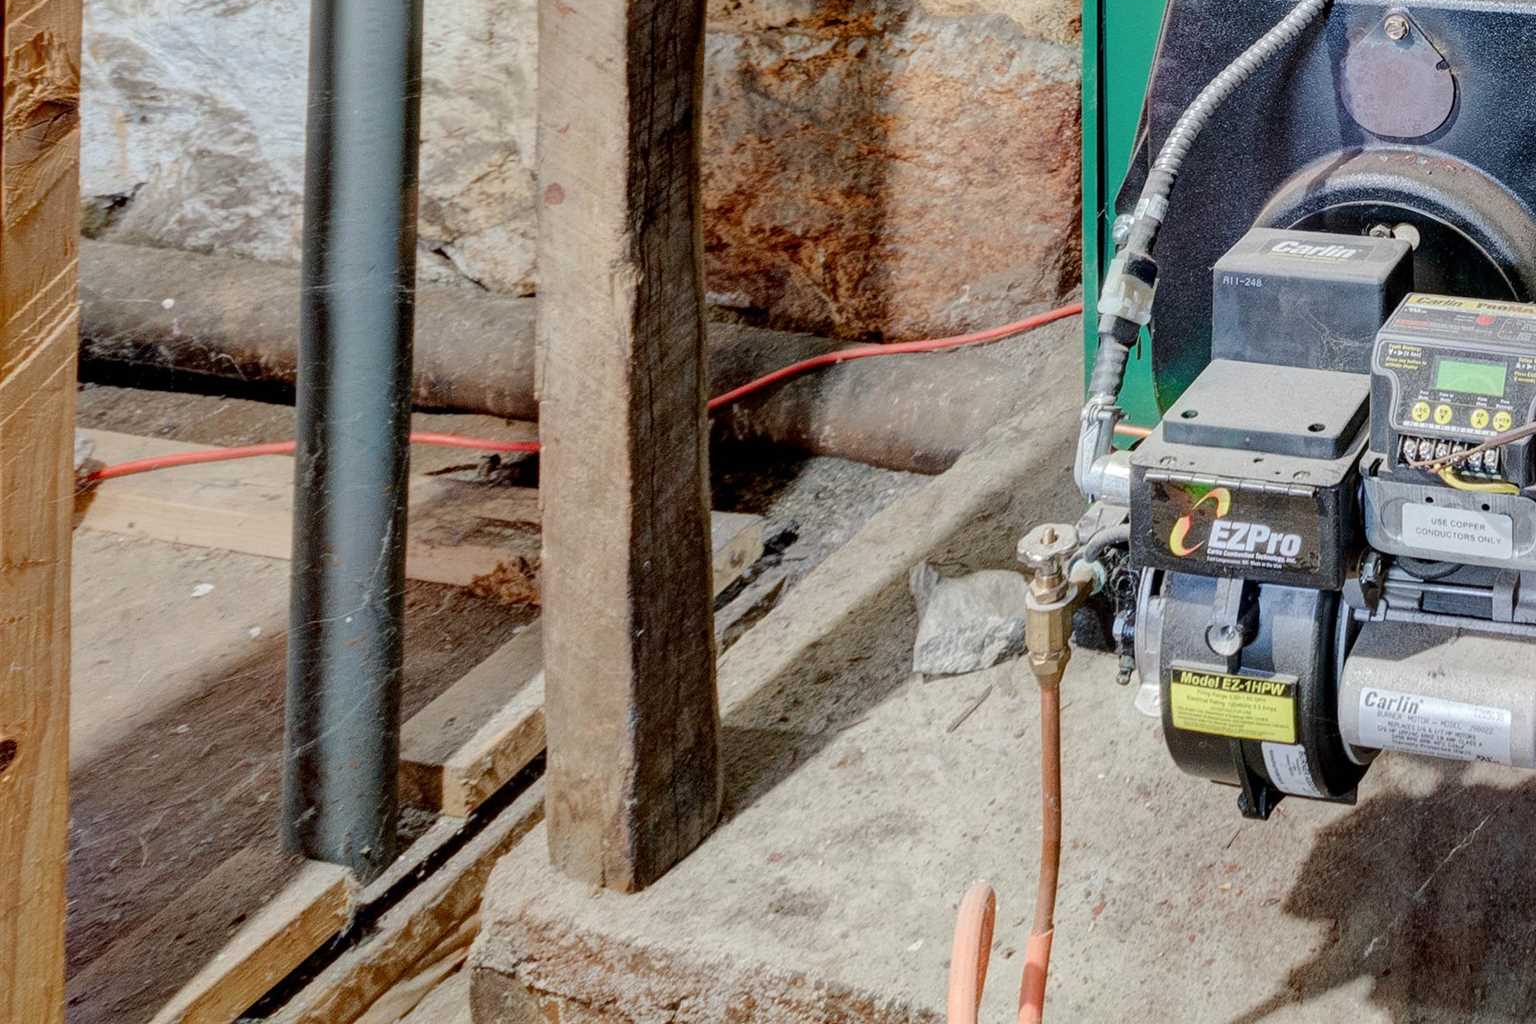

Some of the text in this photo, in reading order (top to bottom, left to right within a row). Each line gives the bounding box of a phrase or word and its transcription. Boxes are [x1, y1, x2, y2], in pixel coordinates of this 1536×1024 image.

[1271, 240, 1357, 259] Carlin
[1430, 517, 1486, 531] USE COPPER
[1207, 519, 1302, 557] EZPro
[1415, 527, 1502, 545] CONDUCTORS ONLY
[1180, 671, 1286, 696] Model EZ-1HPW
[1364, 690, 1420, 715] Carlin
